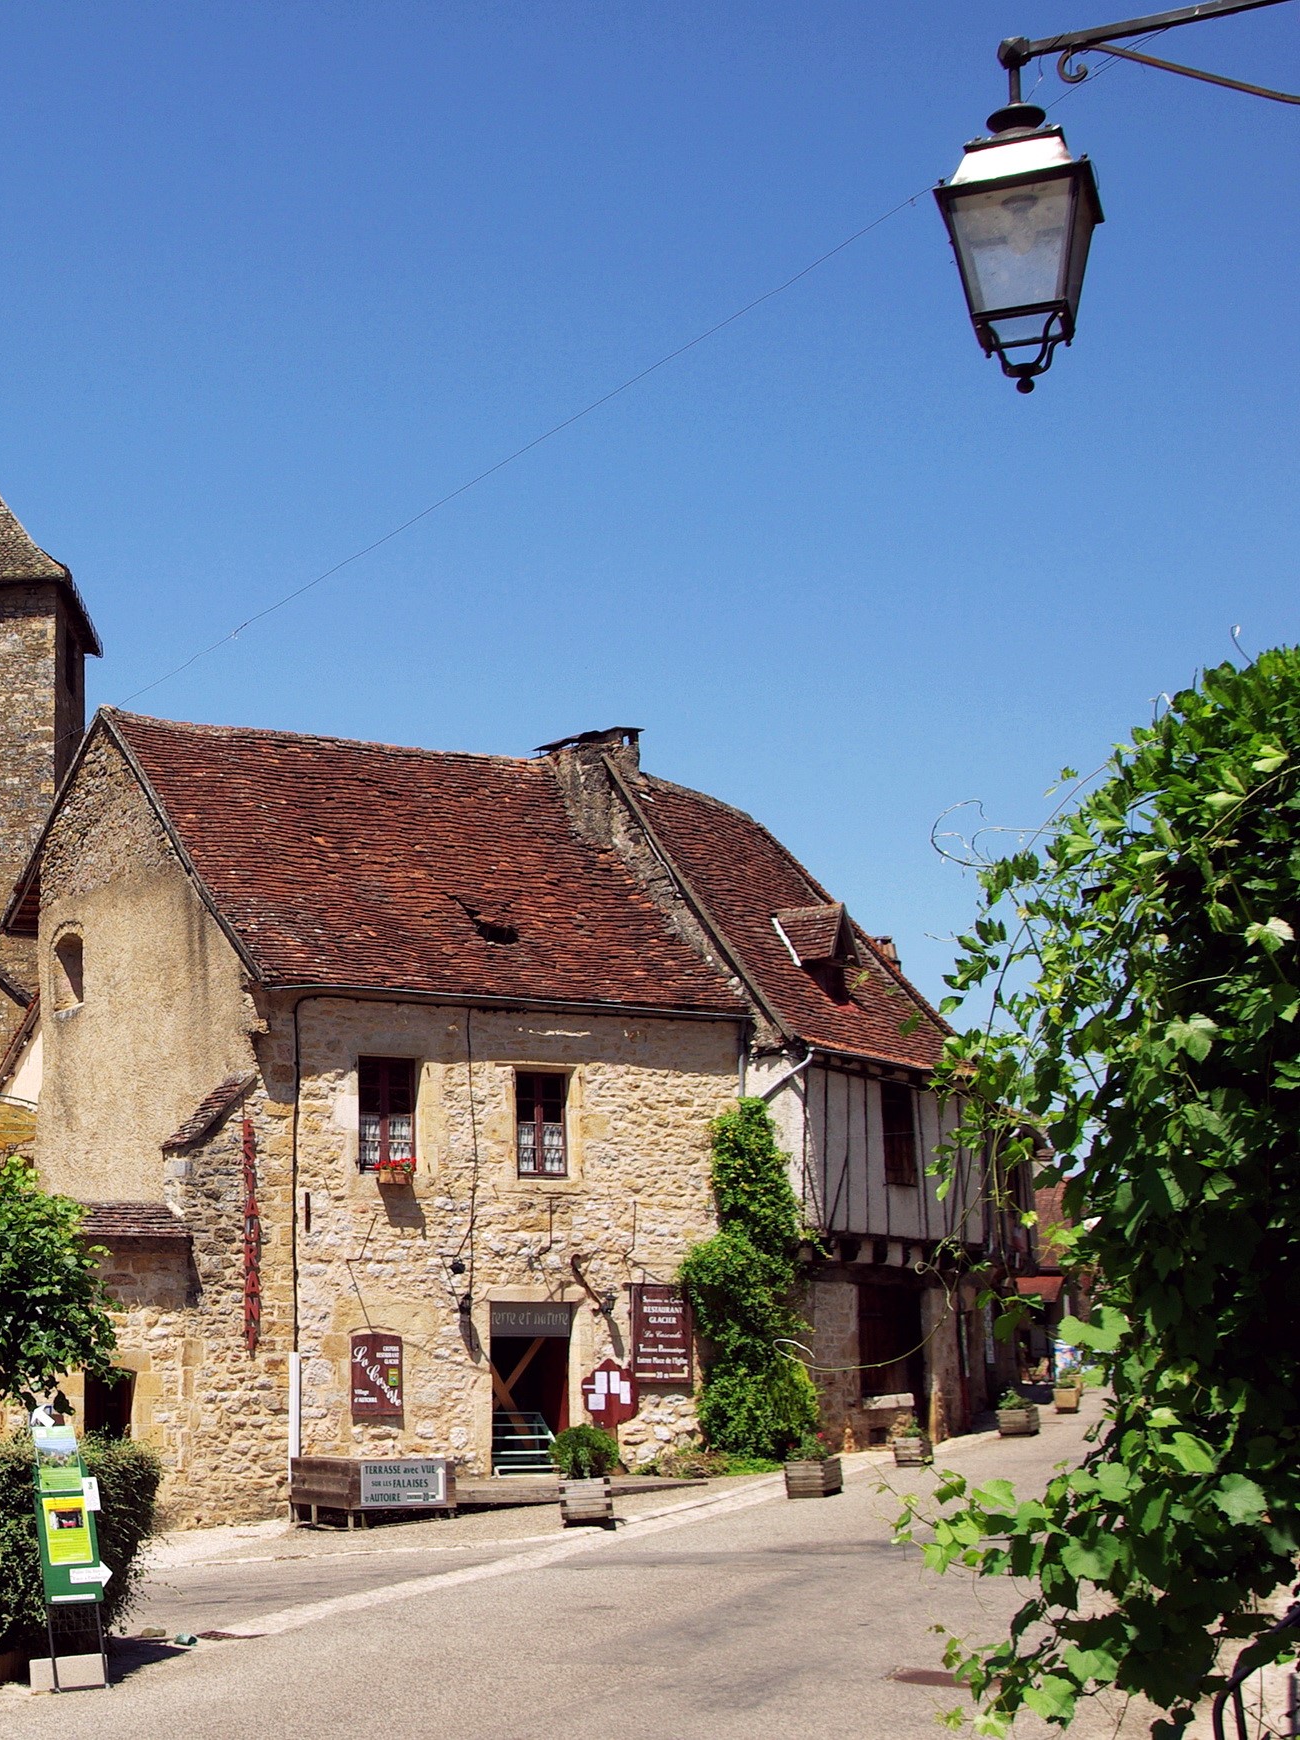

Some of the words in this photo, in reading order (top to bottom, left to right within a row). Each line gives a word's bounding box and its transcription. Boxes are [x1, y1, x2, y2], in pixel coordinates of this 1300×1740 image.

[643, 1306, 683, 1314] RESTAURANT
[492, 1312, 516, 1325] terre
[519, 1312, 531, 1325] et
[533, 1312, 569, 1326] nature
[648, 1316, 677, 1324] GLACIER
[352, 1346, 368, 1367] La
[366, 1364, 402, 1407] Cascade
[365, 1465, 401, 1475] TERRASSE
[403, 1466, 419, 1475] avec
[421, 1465, 436, 1474] VUE
[392, 1479, 429, 1488] FALAISES
